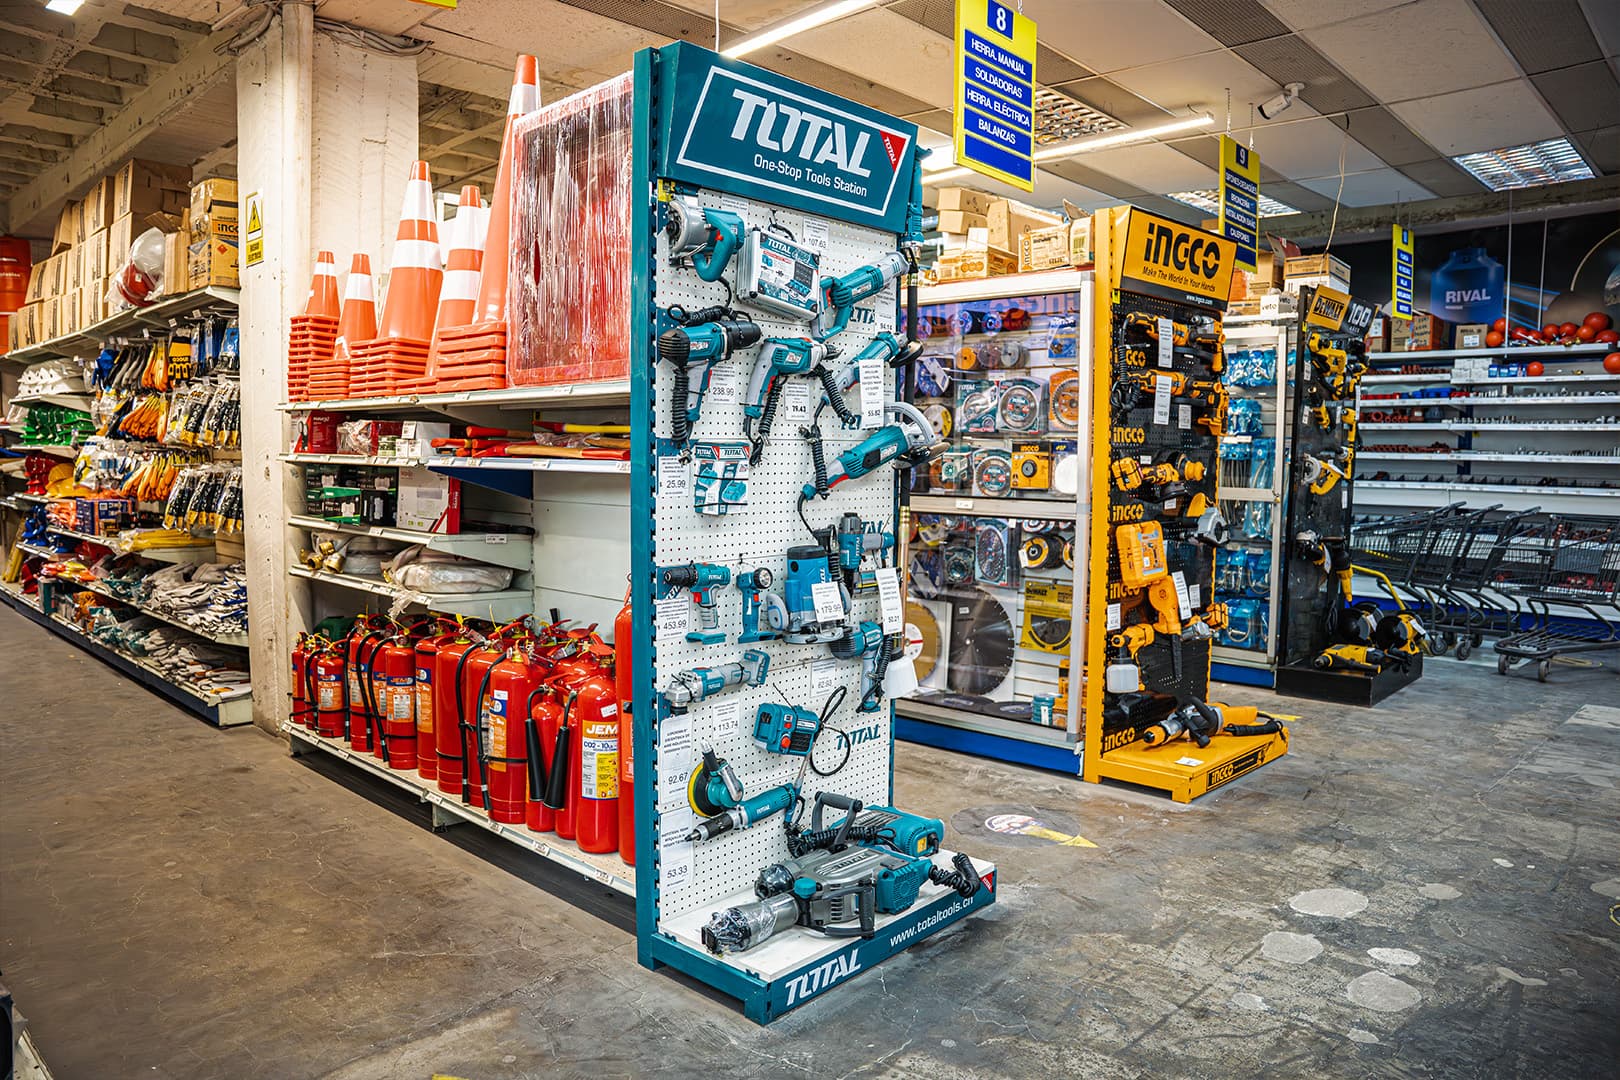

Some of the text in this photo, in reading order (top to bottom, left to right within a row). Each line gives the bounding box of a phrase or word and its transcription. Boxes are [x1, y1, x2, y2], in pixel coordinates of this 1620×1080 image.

[996, 8, 1007, 31] 8
[971, 38, 1026, 76] HERRA. MANUAL
[975, 67, 1023, 99] SOLDADORAS
[967, 88, 1030, 127] HERRA. ELÉCTRICA
[731, 88, 871, 178] TOTAL
[978, 119, 1016, 145] BALANZAS
[884, 137, 897, 164] TOTAL
[1240, 148, 1245, 165] 9
[754, 153, 867, 197] One-Stop Tools Station
[767, 238, 791, 254] TOTAL
[1158, 269, 1167, 280] The
[1169, 272, 1183, 284] World
[1190, 278, 1200, 289] Your
[1201, 281, 1216, 292] Hands
[1445, 288, 1491, 303] RIVAL
[1348, 303, 1372, 328] 100
[712, 387, 735, 397] 238.99
[667, 480, 686, 488] 25.99
[663, 620, 687, 630] 453.99
[719, 720, 738, 731] 113.74
[668, 772, 688, 785] 92.67
[667, 865, 688, 878] 53.33
[890, 897, 974, 947] www.totaltools.cn
[785, 949, 862, 1006] TOTAL
